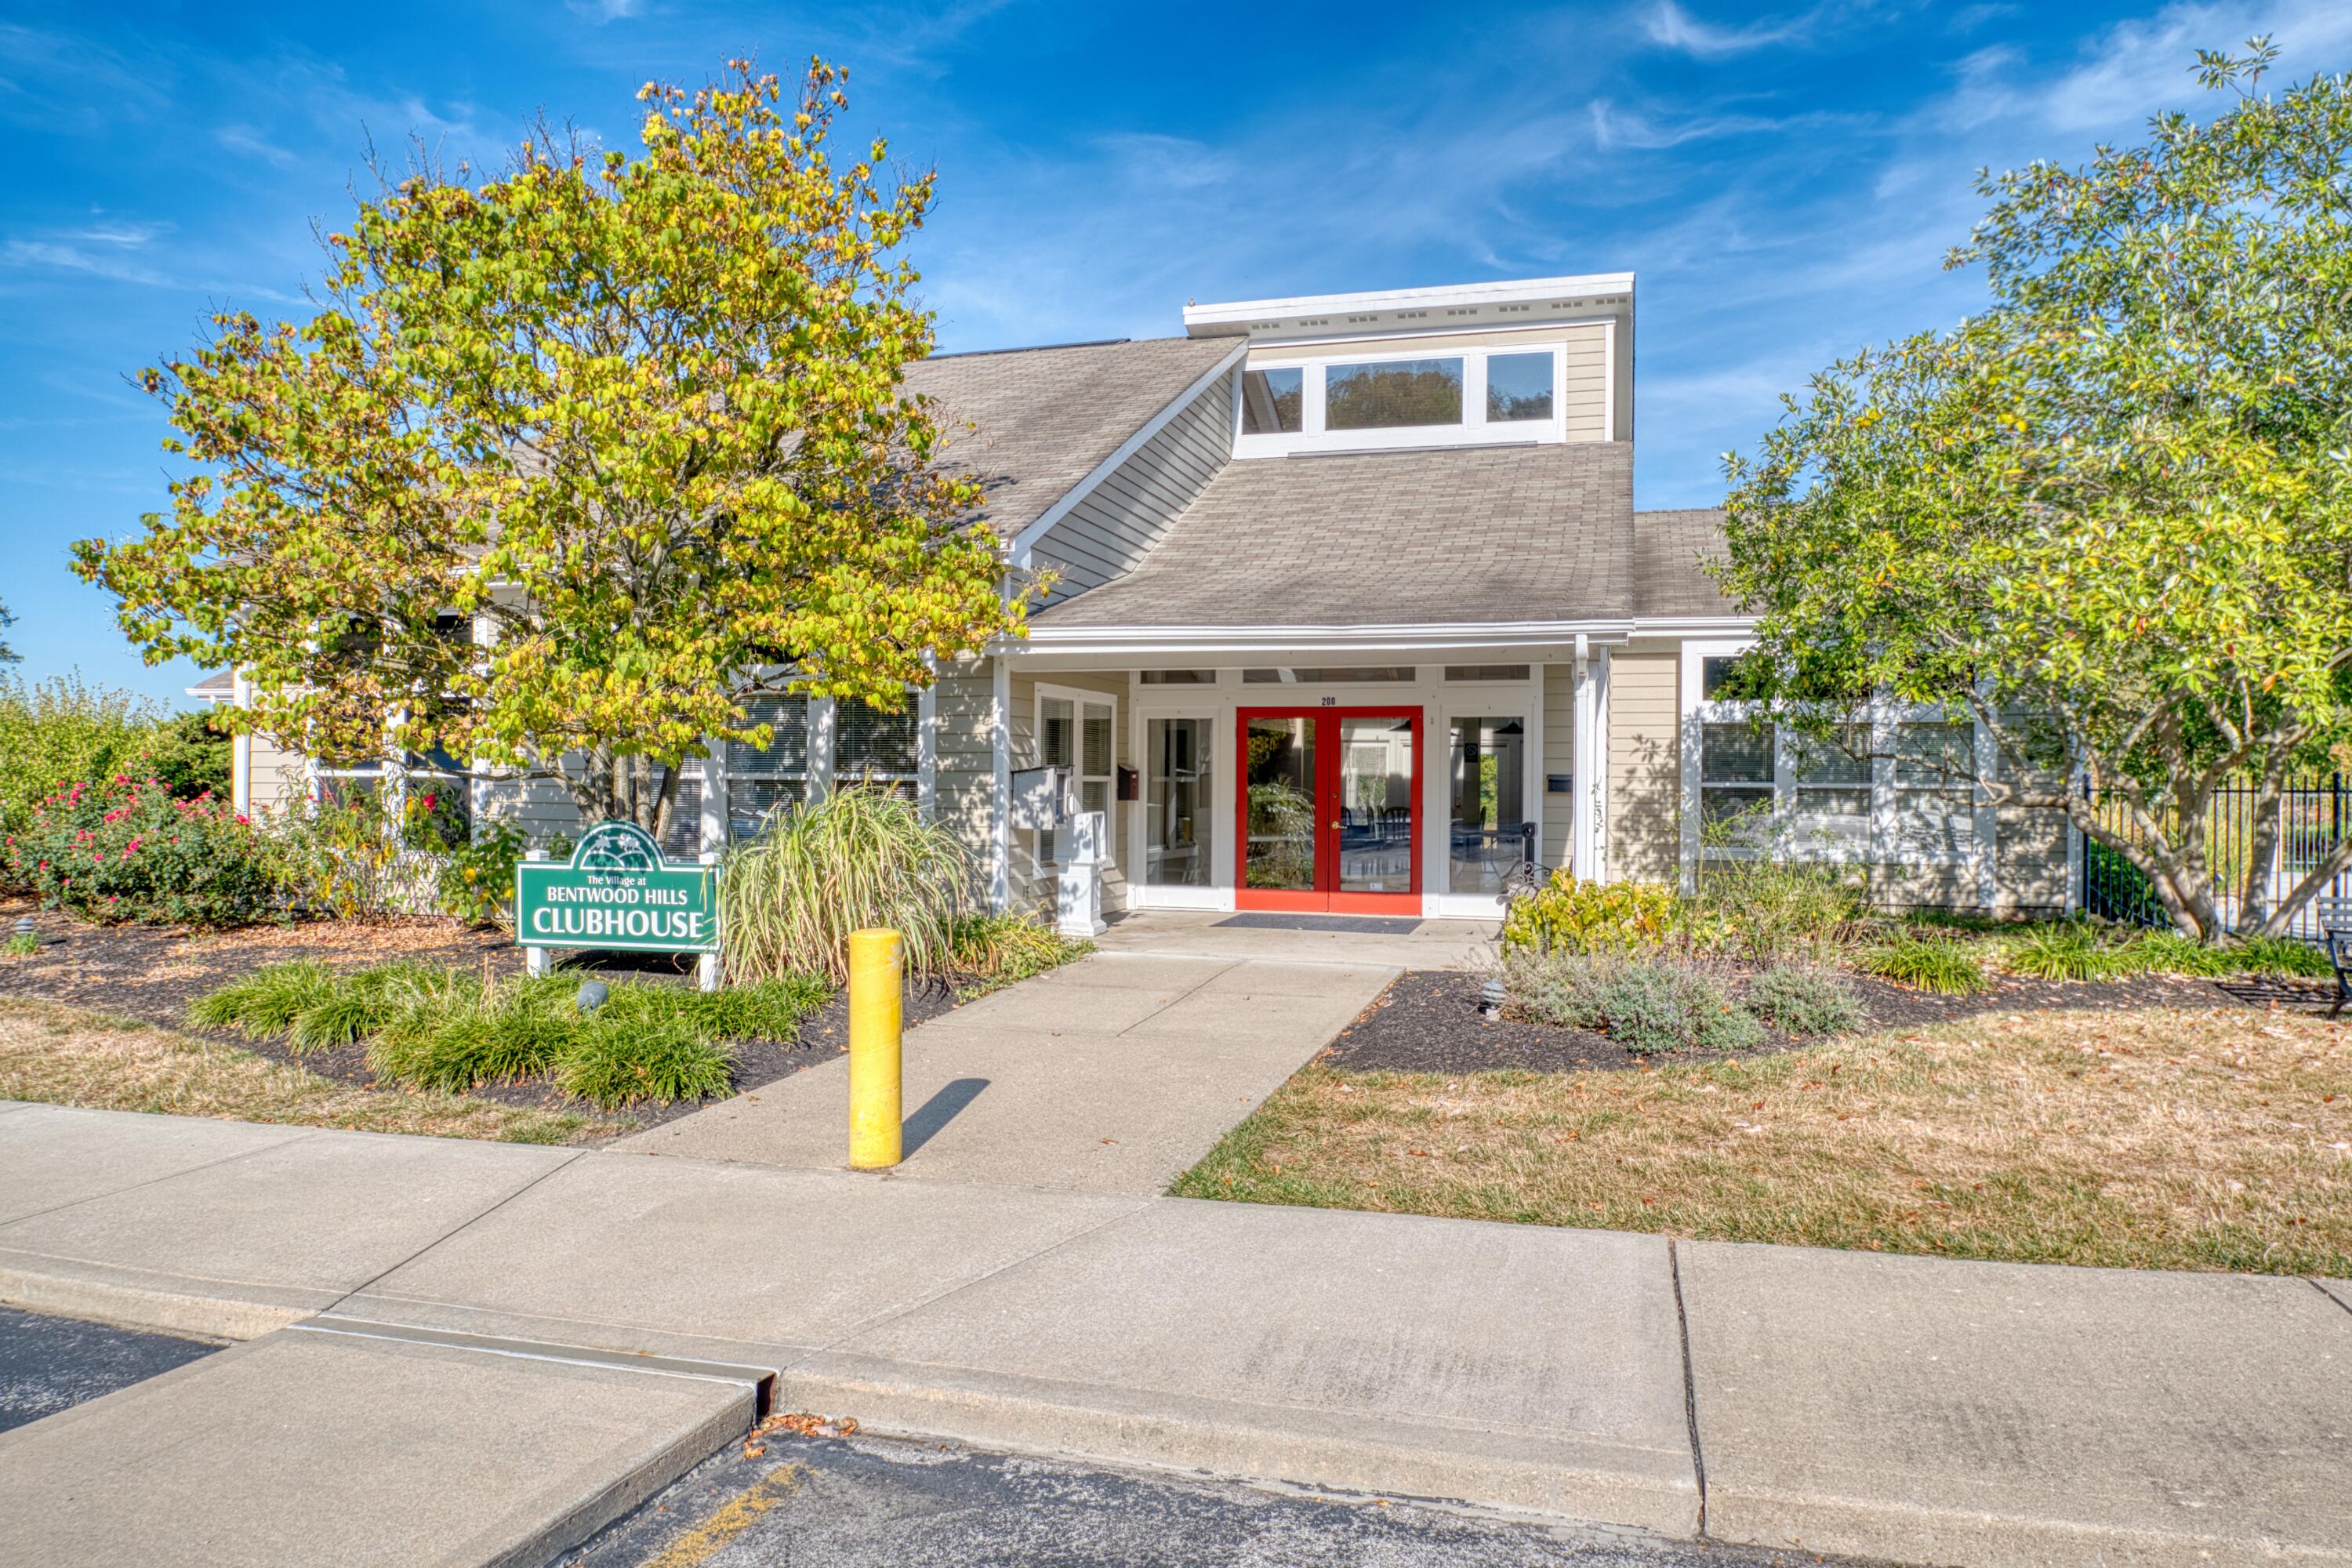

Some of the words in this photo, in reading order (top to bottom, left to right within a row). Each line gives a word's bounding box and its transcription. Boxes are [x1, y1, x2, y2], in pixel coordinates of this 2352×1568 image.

[1322, 697, 1335, 706] 200
[586, 875, 604, 885] The
[605, 876, 635, 887] Village
[547, 887, 639, 903] BENTWOOD
[644, 889, 688, 905] HILLS
[533, 907, 704, 938] CLUBHOUSE
